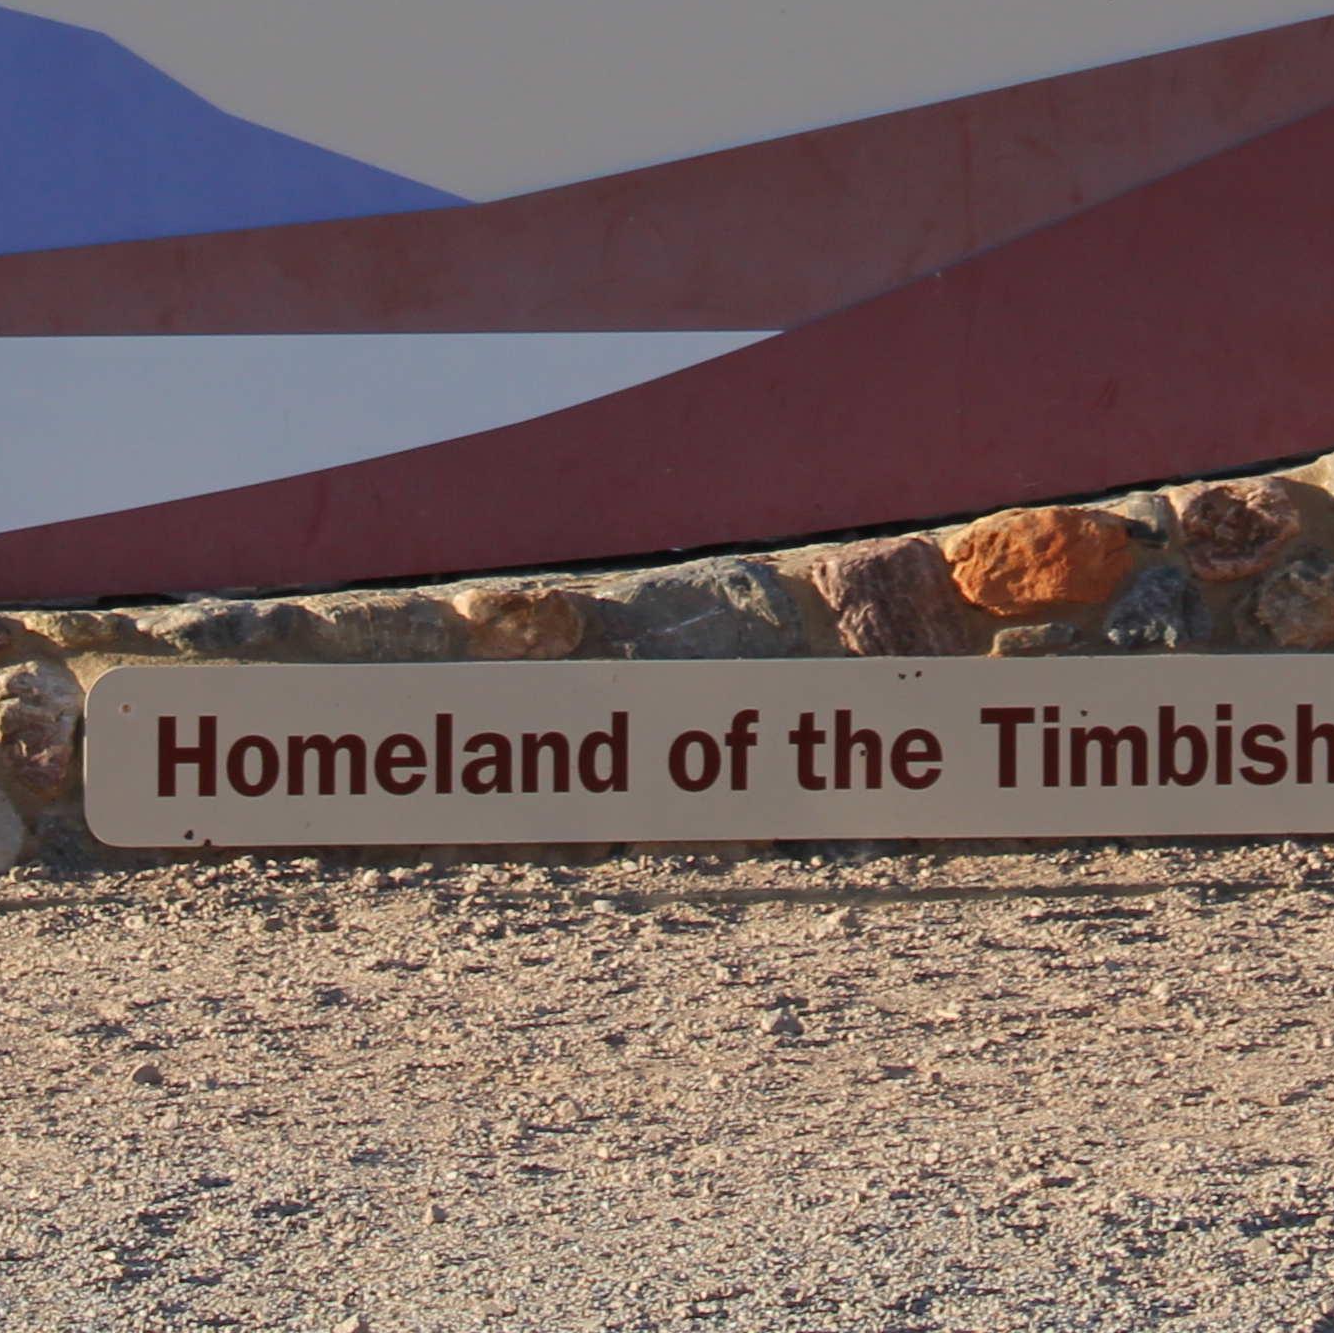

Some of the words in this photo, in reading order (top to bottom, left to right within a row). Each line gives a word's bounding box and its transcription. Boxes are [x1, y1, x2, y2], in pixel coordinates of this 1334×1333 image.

[157, 711, 629, 798] Homeland
[668, 708, 760, 793] of
[788, 709, 943, 791] the
